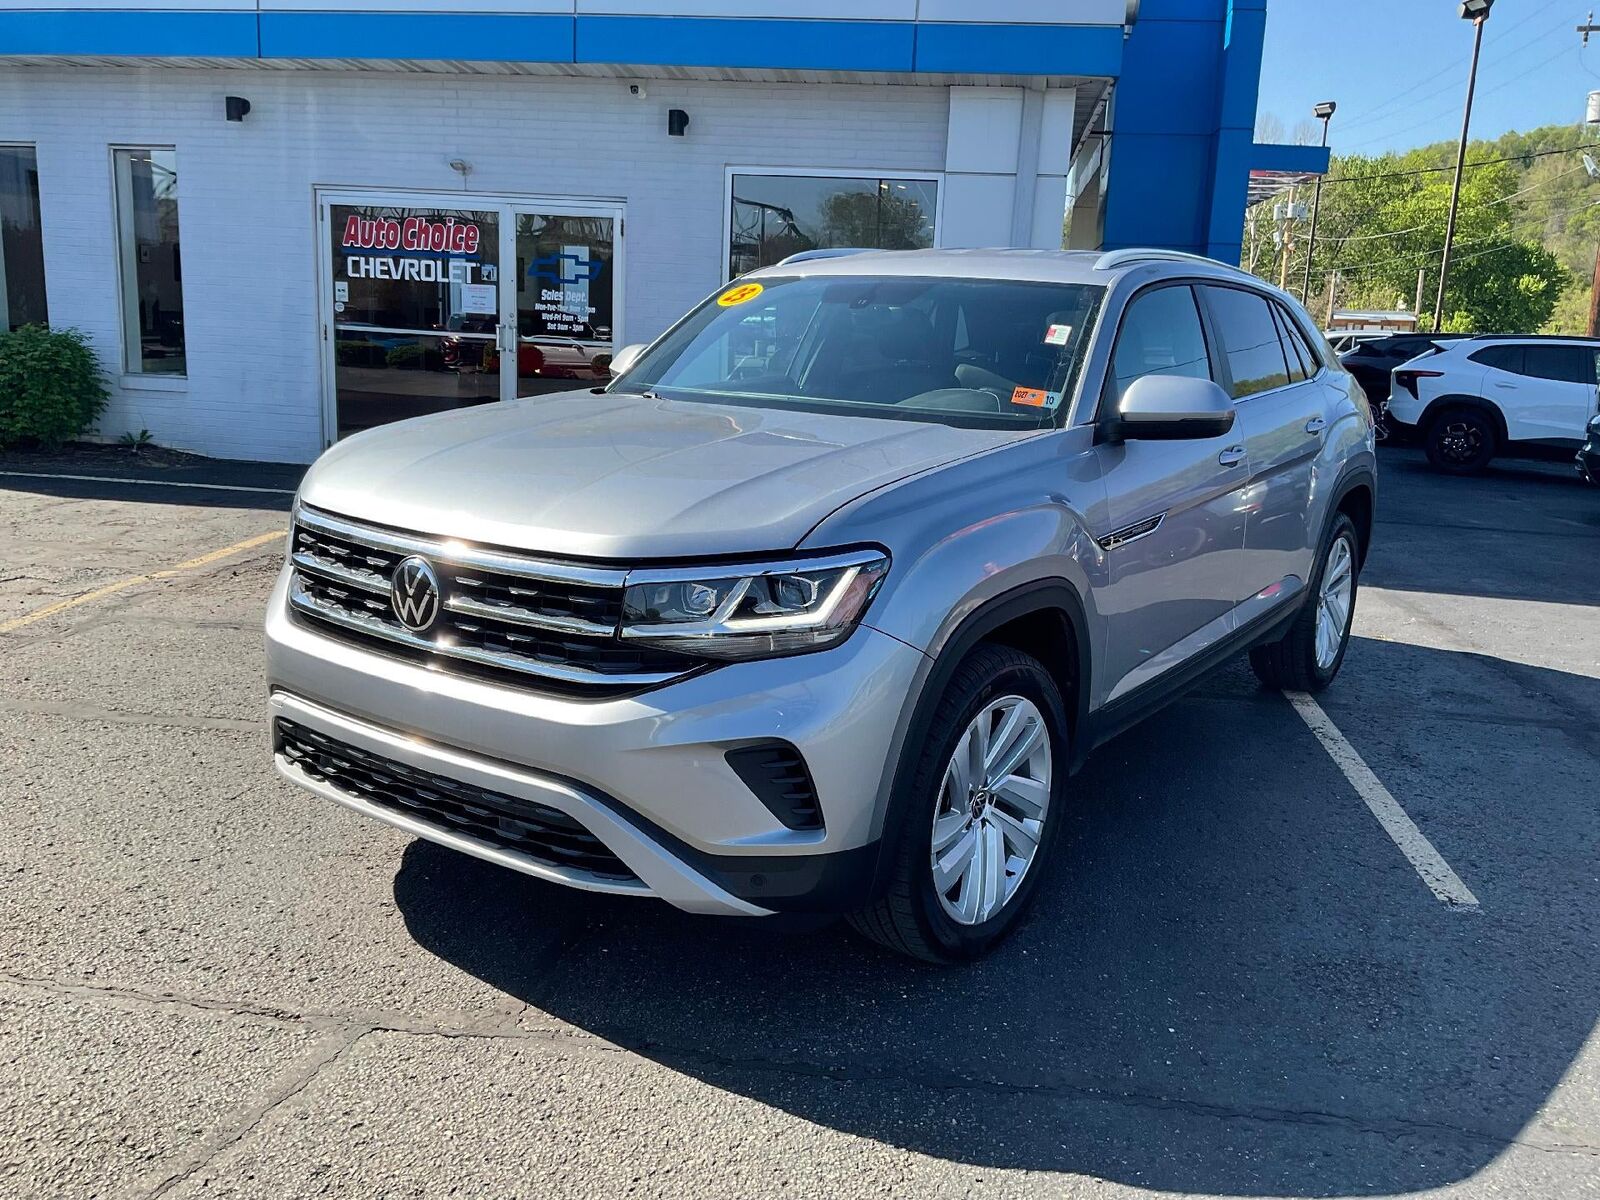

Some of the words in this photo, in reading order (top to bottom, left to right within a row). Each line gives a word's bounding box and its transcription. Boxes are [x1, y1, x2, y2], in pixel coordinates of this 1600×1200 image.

[342, 215, 400, 249] Auto
[402, 217, 479, 254] Choice
[347, 256, 477, 284] CHEVROLET
[541, 289, 563, 301] Sales
[565, 290, 587, 303] Dept.
[546, 322, 557, 330] Sat
[1045, 395, 1054, 405] 10
